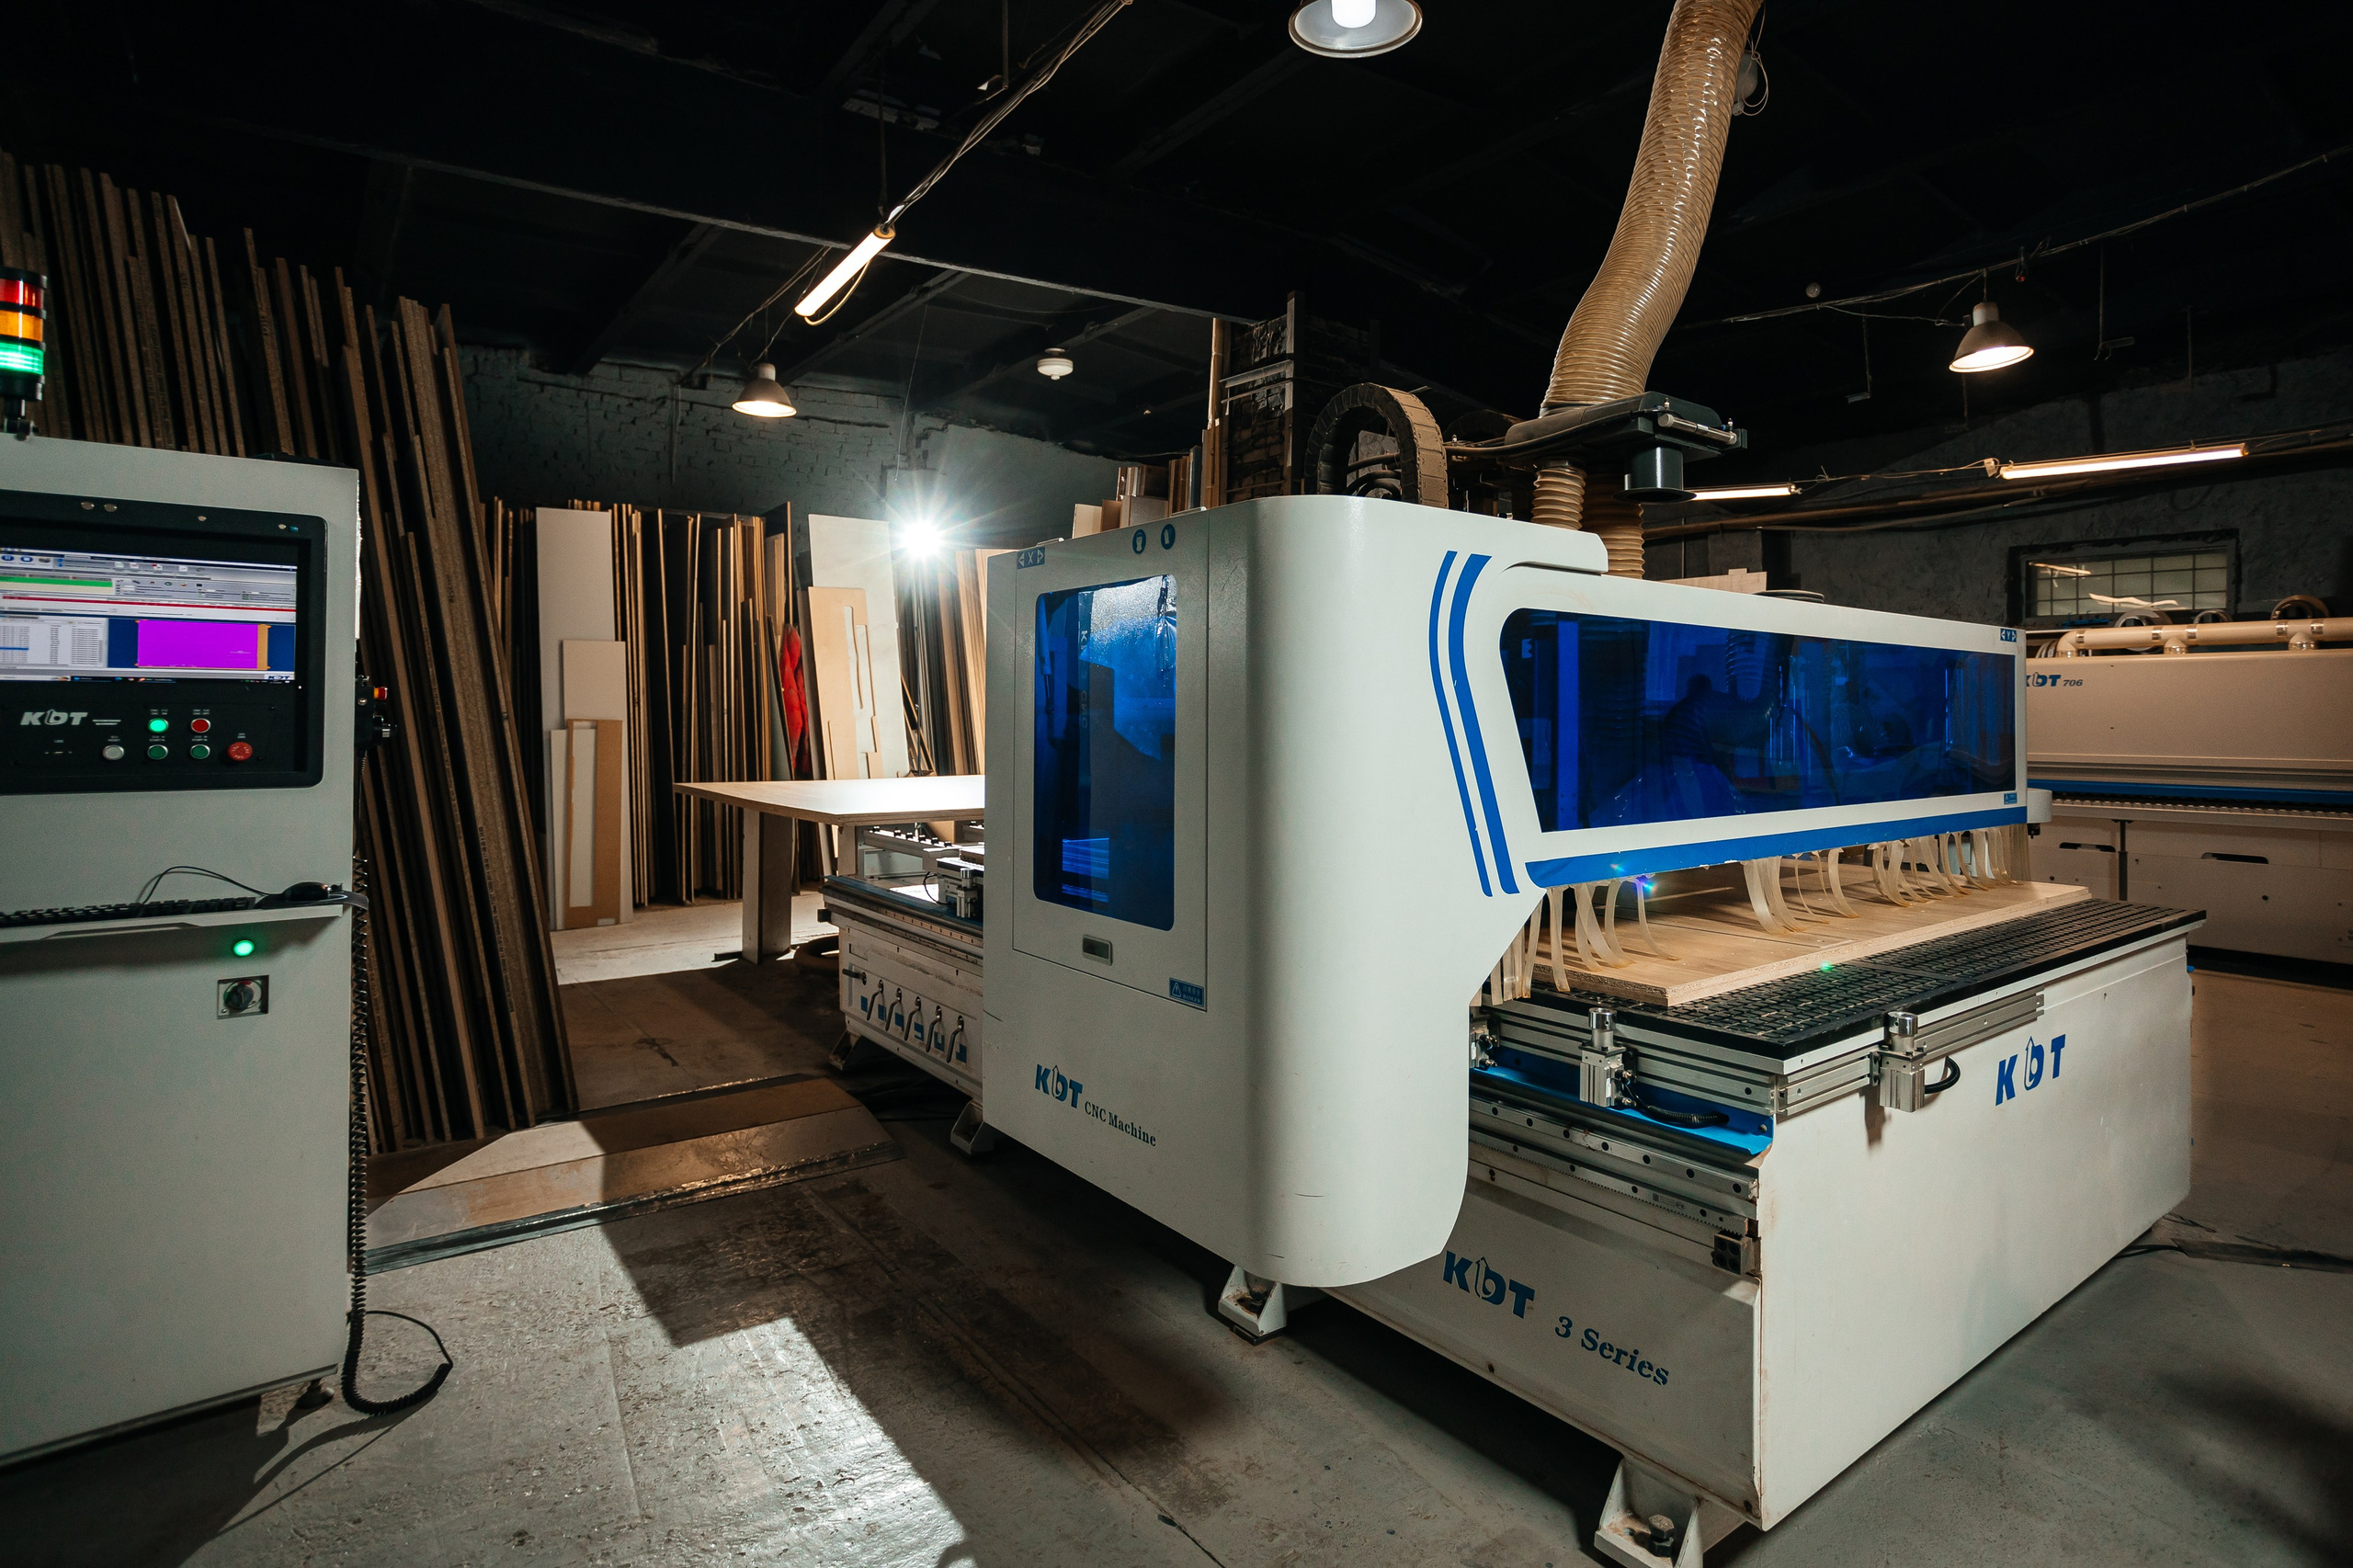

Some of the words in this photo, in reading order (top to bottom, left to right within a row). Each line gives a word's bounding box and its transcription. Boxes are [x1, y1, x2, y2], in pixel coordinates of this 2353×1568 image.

[2026, 672, 2062, 687] DT
[19, 709, 89, 726] KDT
[1034, 1063, 1084, 1109] KDT
[1085, 1100, 1107, 1123] CNC
[1108, 1111, 1156, 1147] Machine
[1995, 1033, 2066, 1107] KDT
[1442, 1250, 1536, 1320] KDT
[1554, 1315, 1574, 1339] 3
[1580, 1327, 1670, 1386] Series
